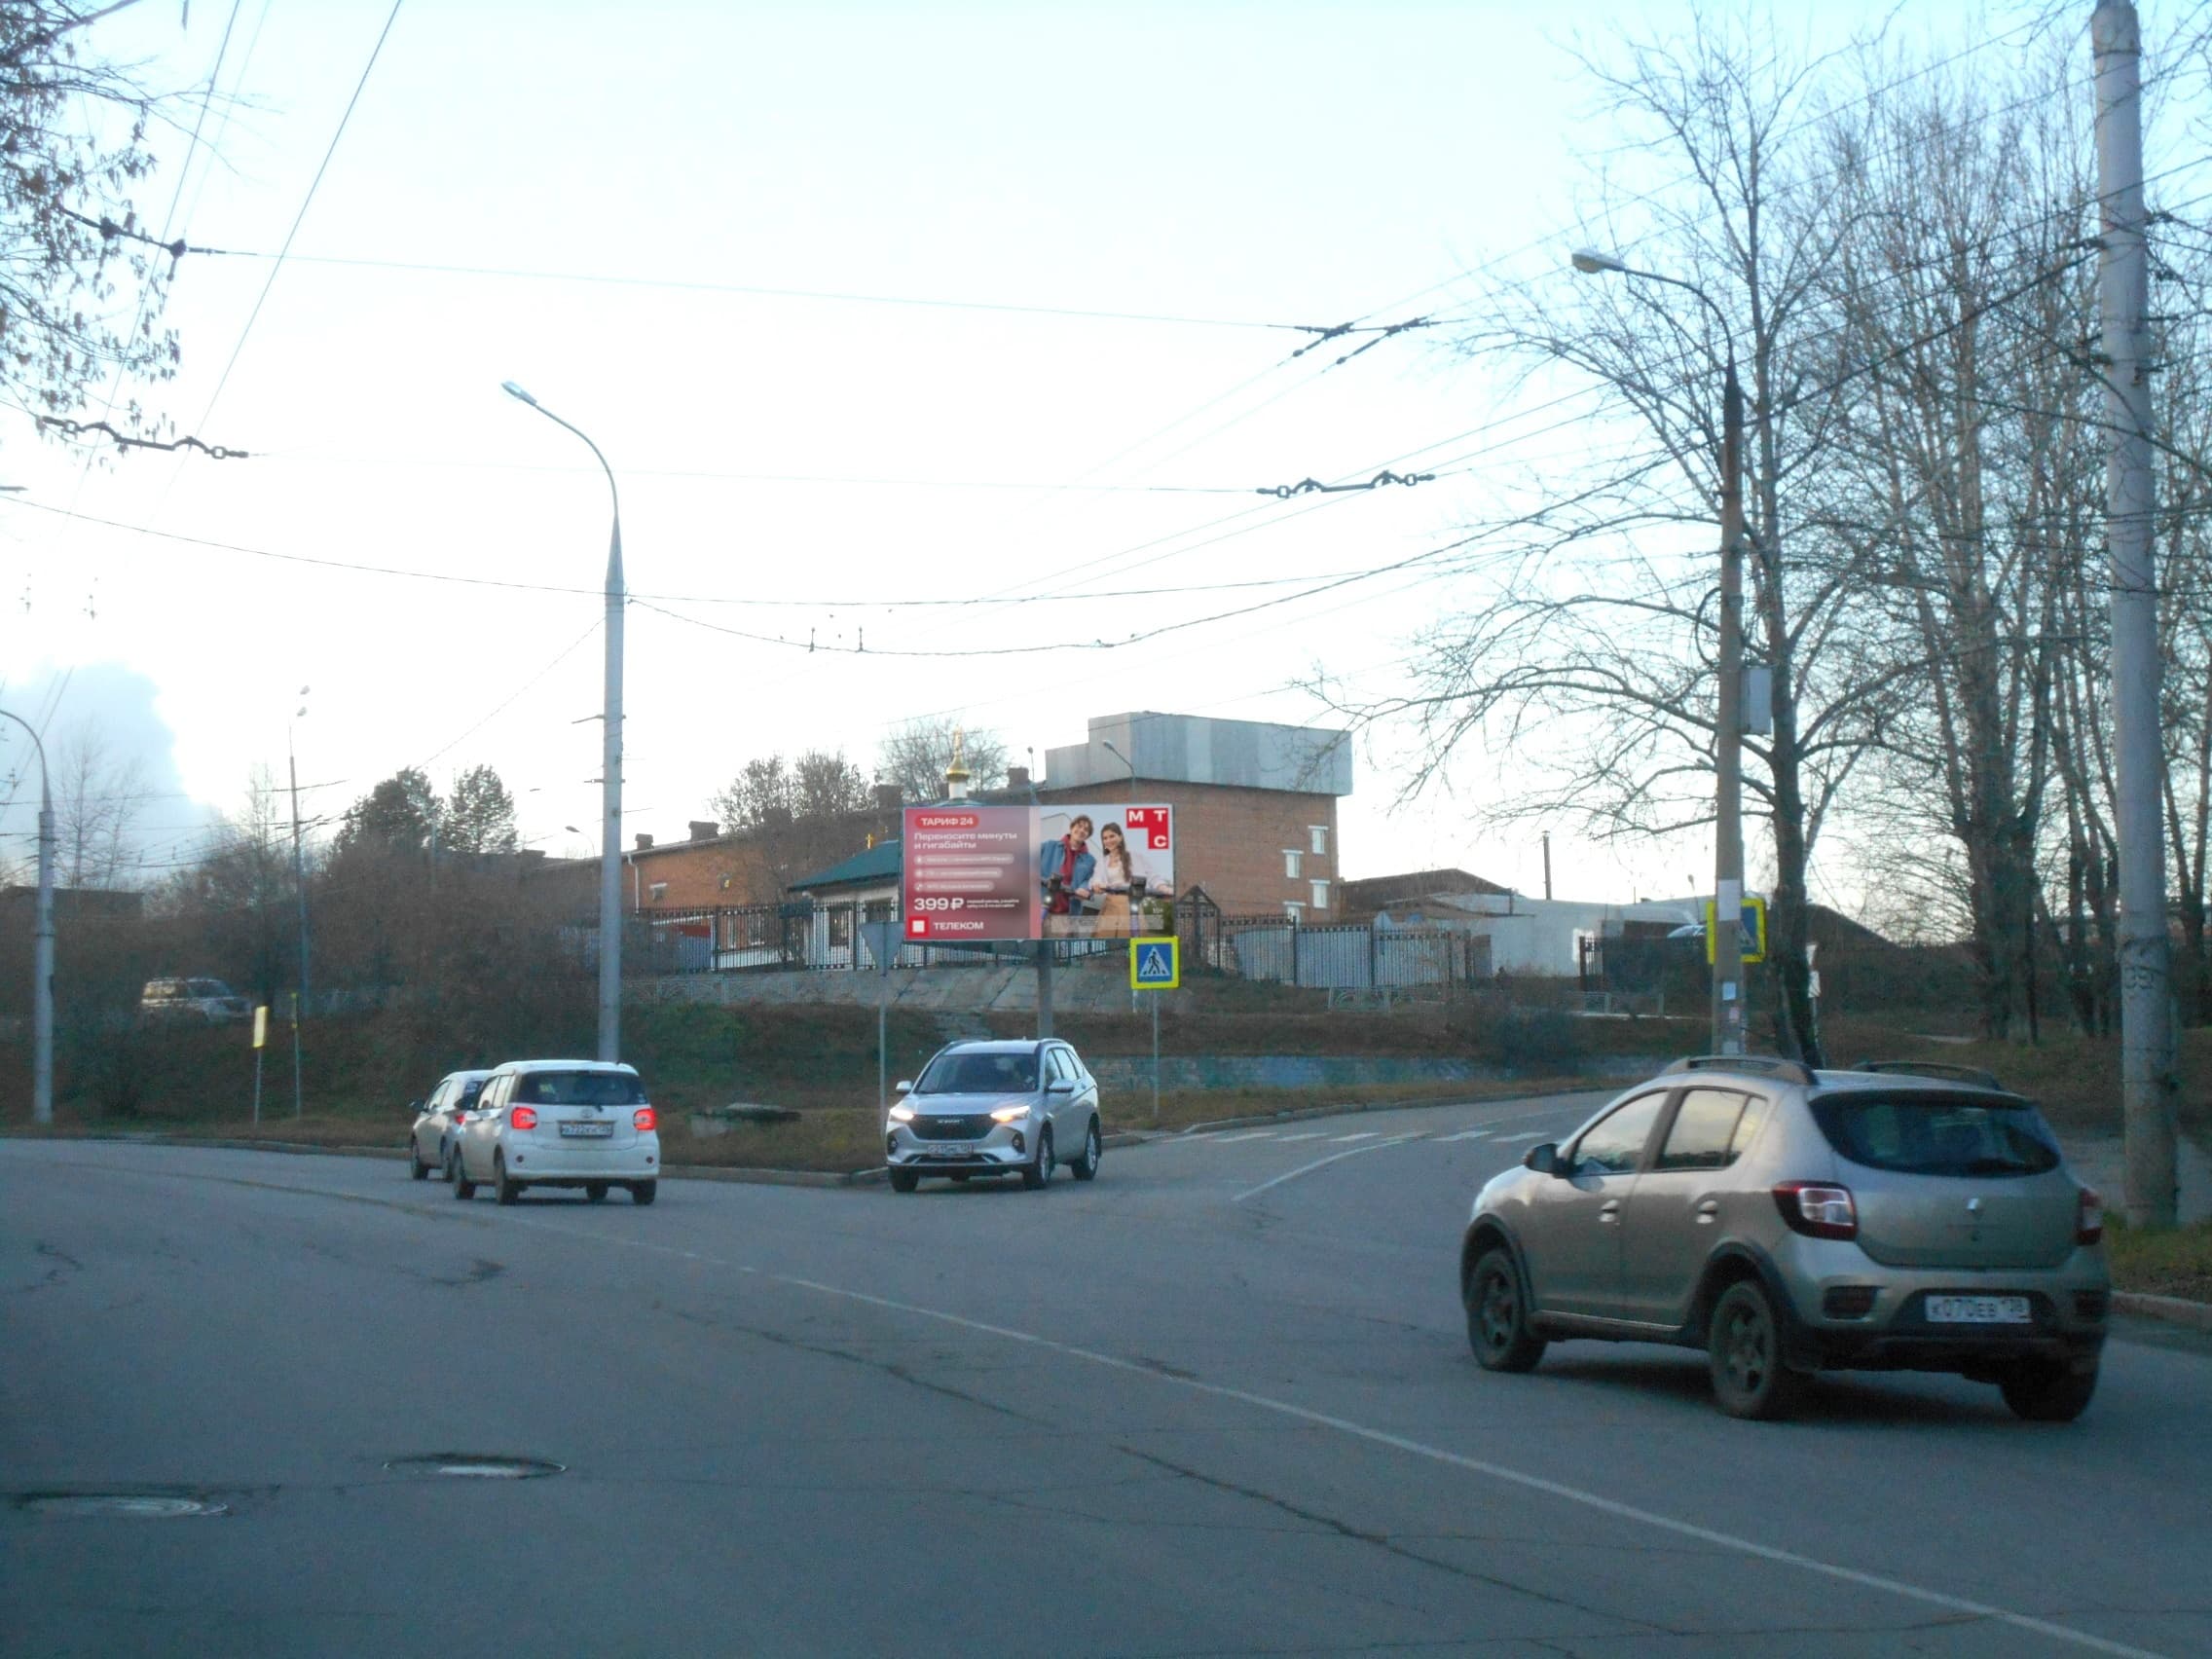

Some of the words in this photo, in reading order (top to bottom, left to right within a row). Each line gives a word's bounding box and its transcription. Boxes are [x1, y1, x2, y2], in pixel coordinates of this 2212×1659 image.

[920, 817, 958, 827] ТАРИФ
[959, 817, 974, 826] 24
[913, 832, 976, 842] Переносите
[977, 832, 1017, 842] минуты
[922, 840, 977, 850] гигабайты
[933, 921, 984, 931] ТЕЛЕКОМ
